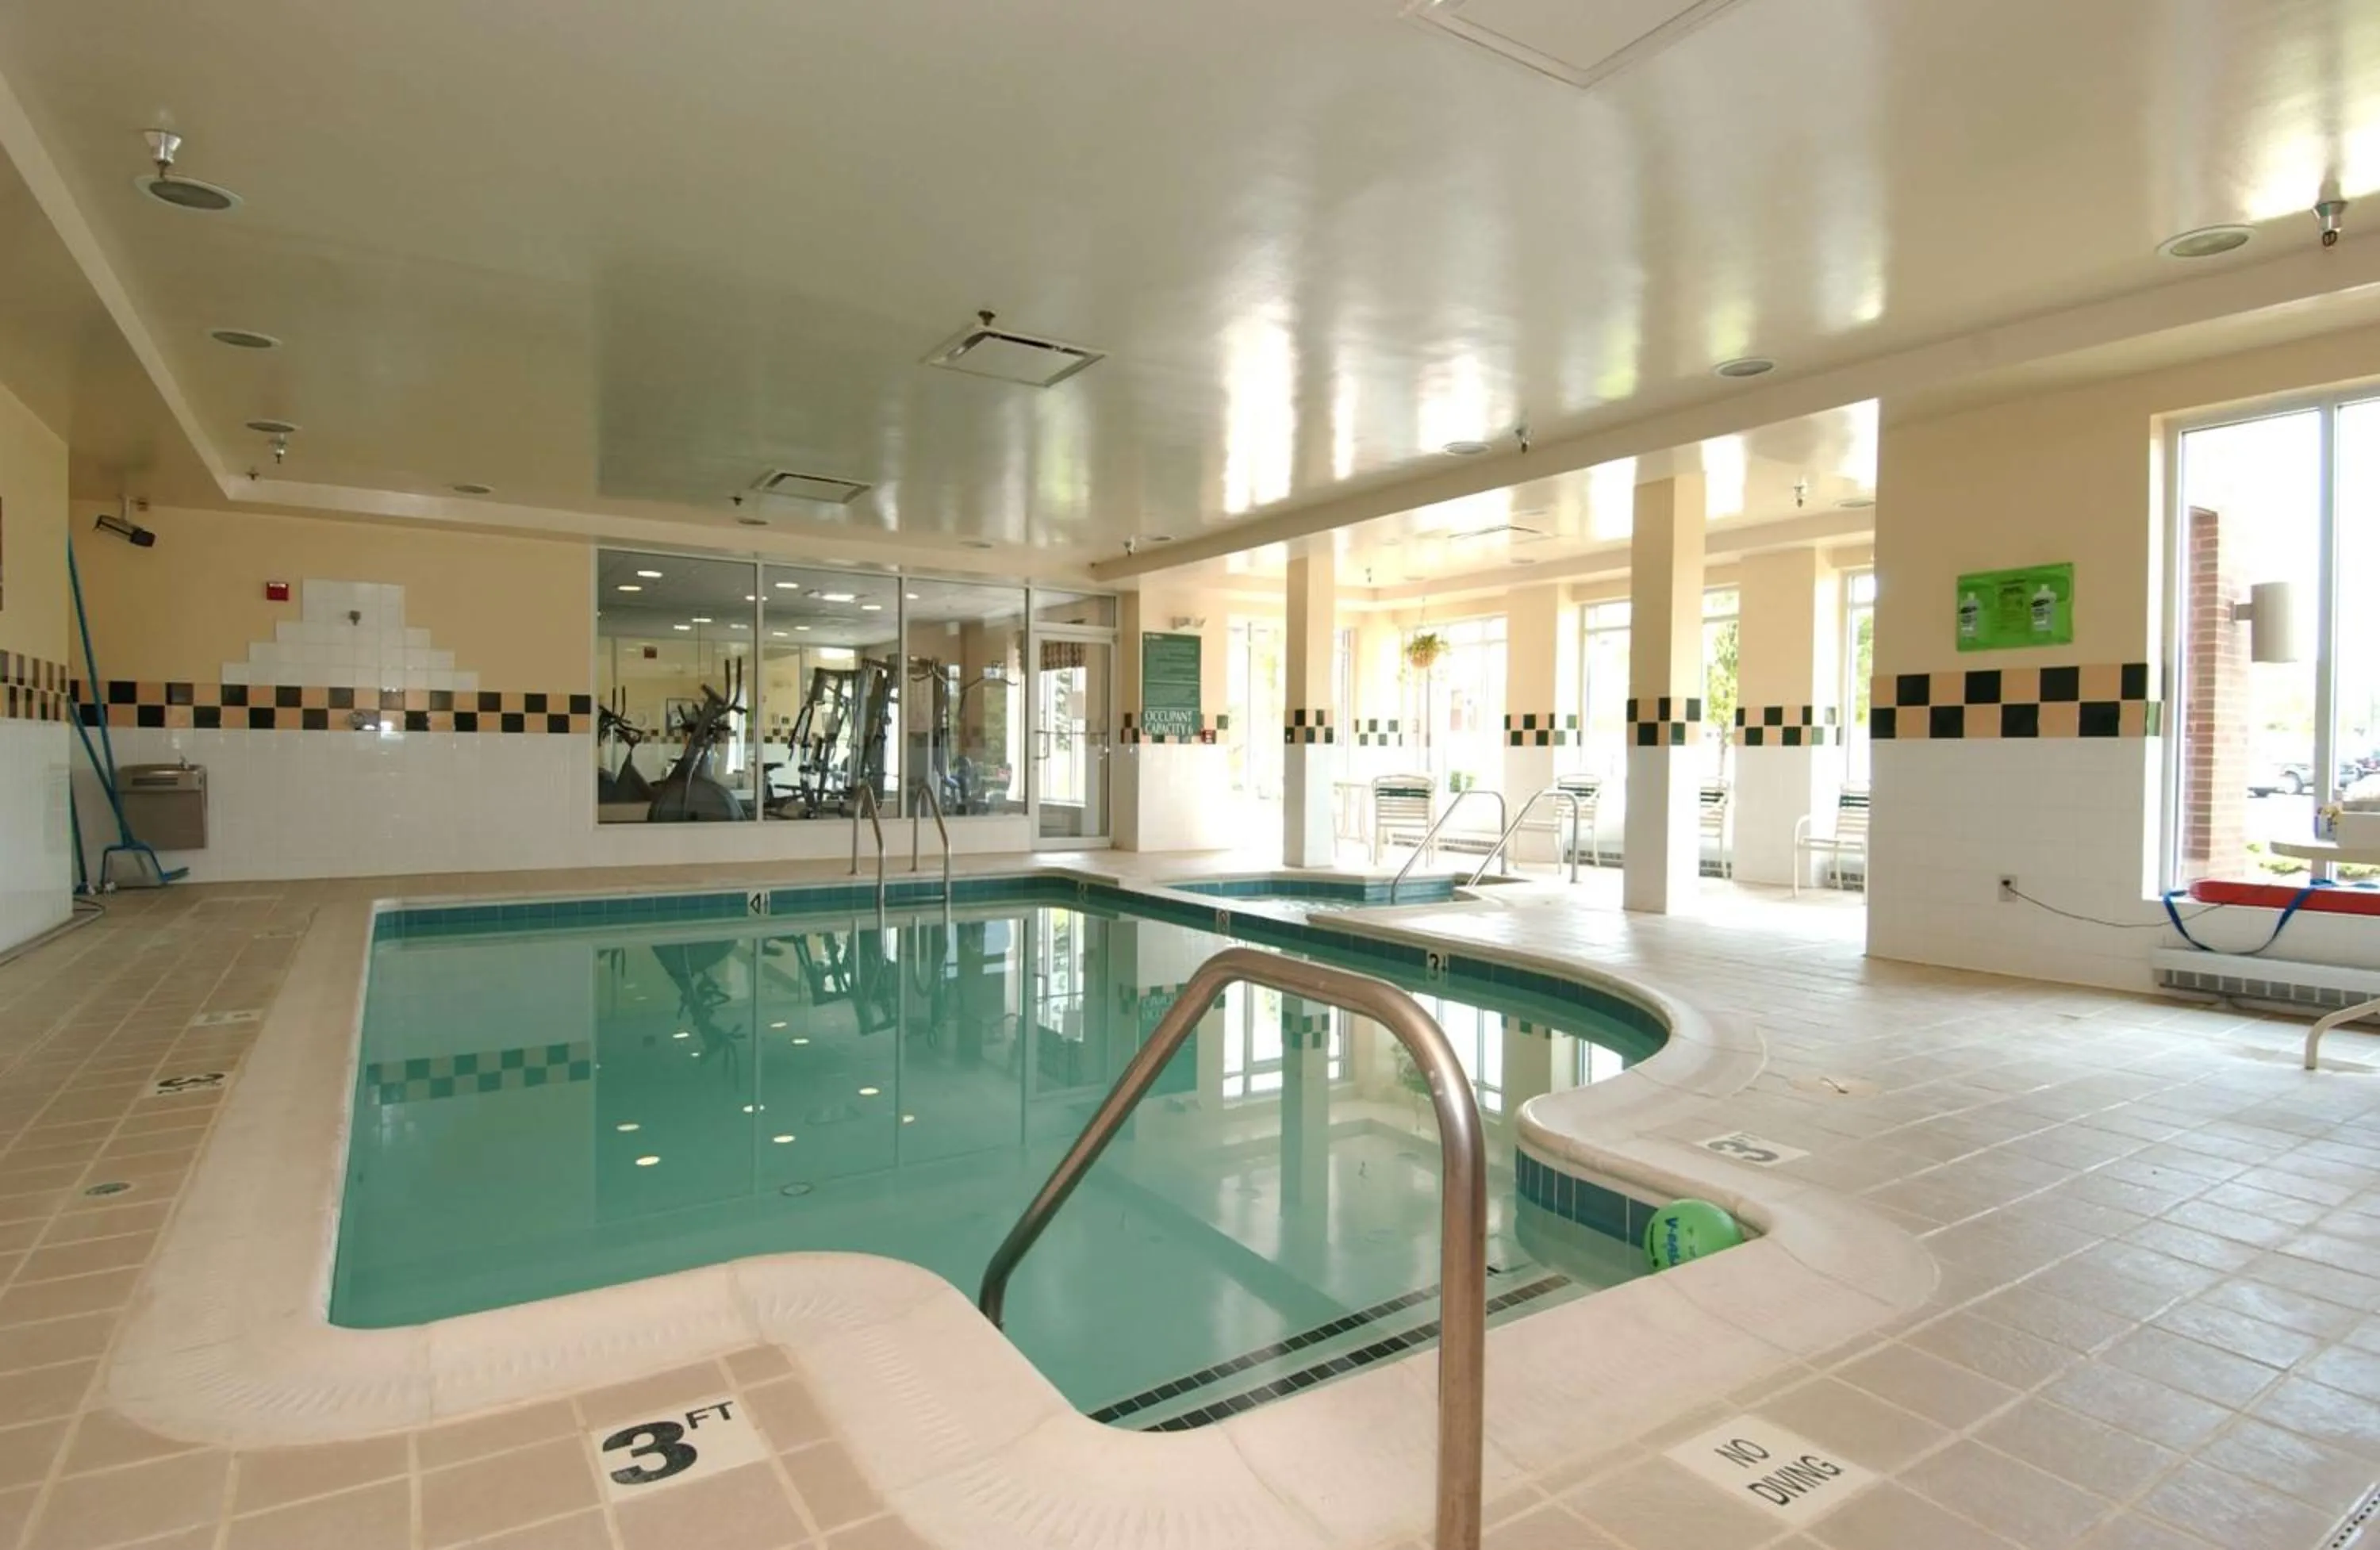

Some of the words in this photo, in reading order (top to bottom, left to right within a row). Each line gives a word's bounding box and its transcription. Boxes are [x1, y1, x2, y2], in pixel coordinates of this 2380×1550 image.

[1144, 710, 1192, 722] OCCUPANT
[1144, 723, 1186, 735] CAPACITY
[1706, 1140, 1779, 1162] 3
[602, 1421, 698, 1485] 3
[685, 1400, 734, 1429] FT
[1713, 1437, 1770, 1468] NO
[1746, 1454, 1844, 1506] DIVING
